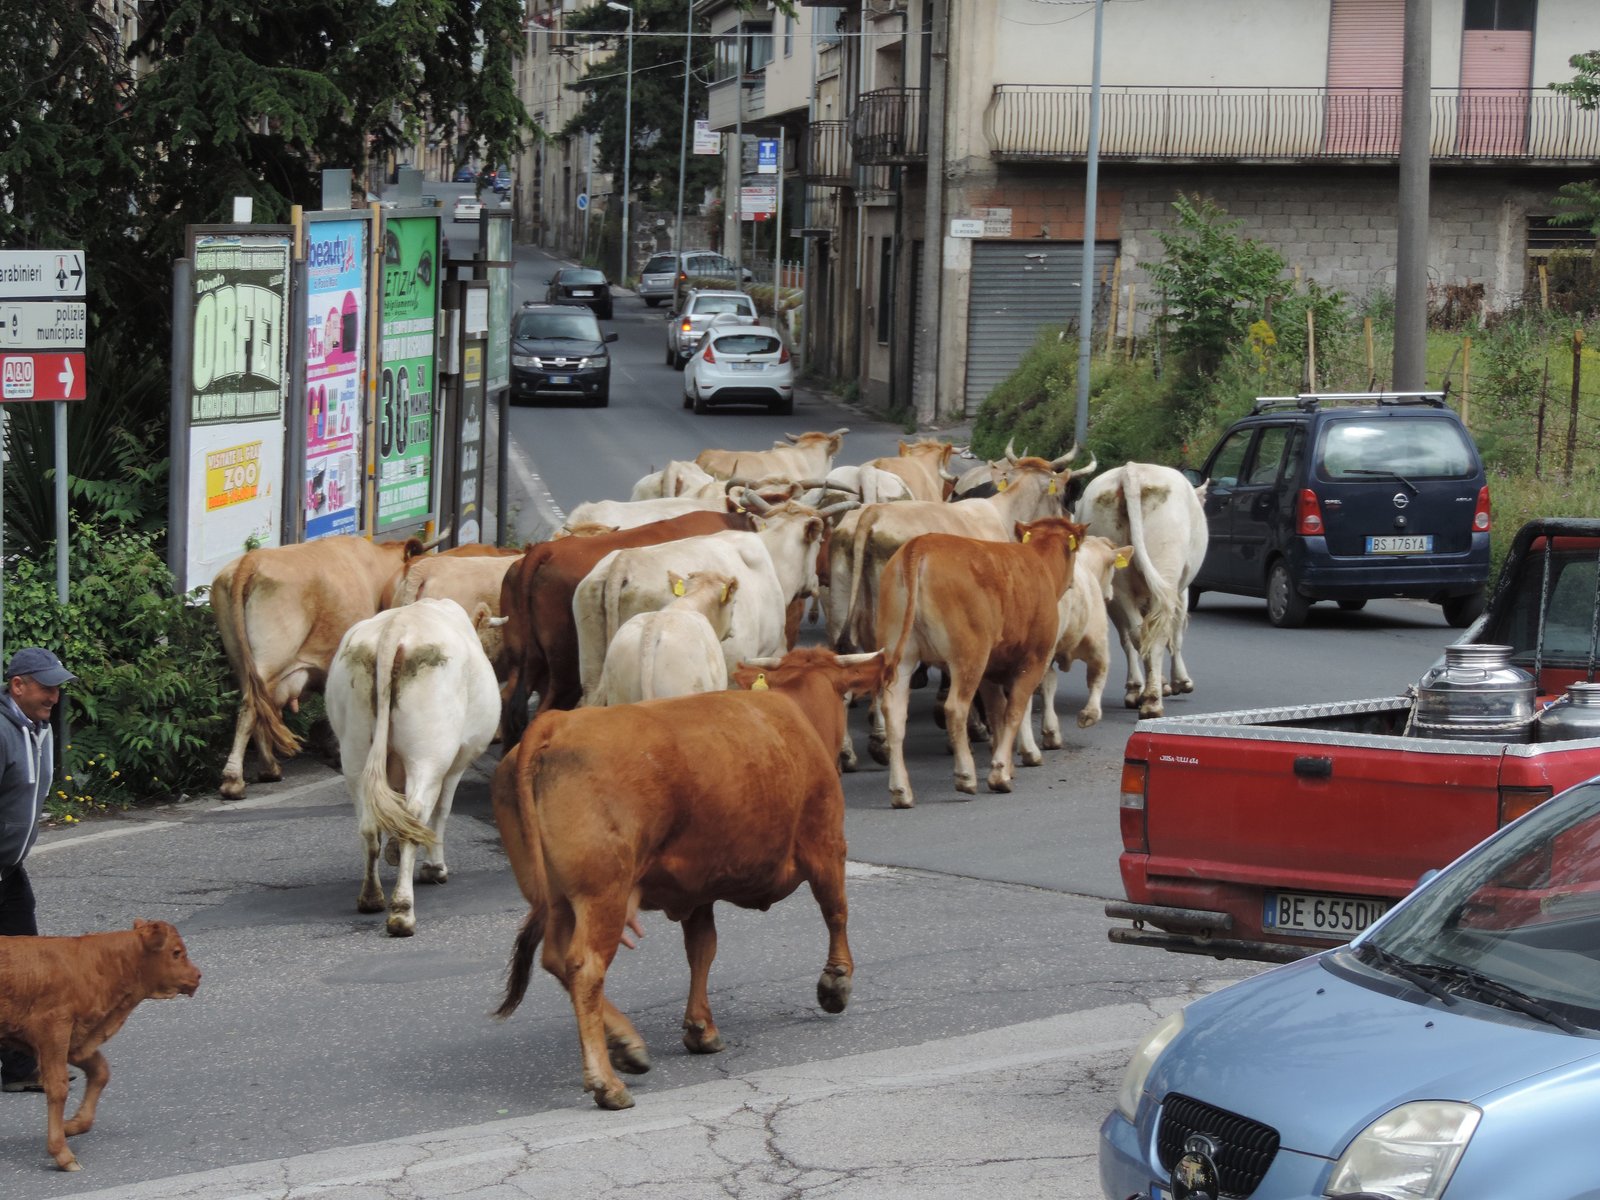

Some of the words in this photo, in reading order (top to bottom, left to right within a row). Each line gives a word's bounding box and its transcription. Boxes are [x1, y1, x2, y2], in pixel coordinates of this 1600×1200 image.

[309, 234, 347, 273] beauty
[196, 273, 225, 293] Donato
[56, 305, 85, 326] polizia
[37, 324, 84, 344] municipale
[193, 283, 282, 391] ORFEI
[5, 361, 32, 382] A&O
[224, 462, 257, 491] ZOO
[1279, 897, 1306, 926] BE
